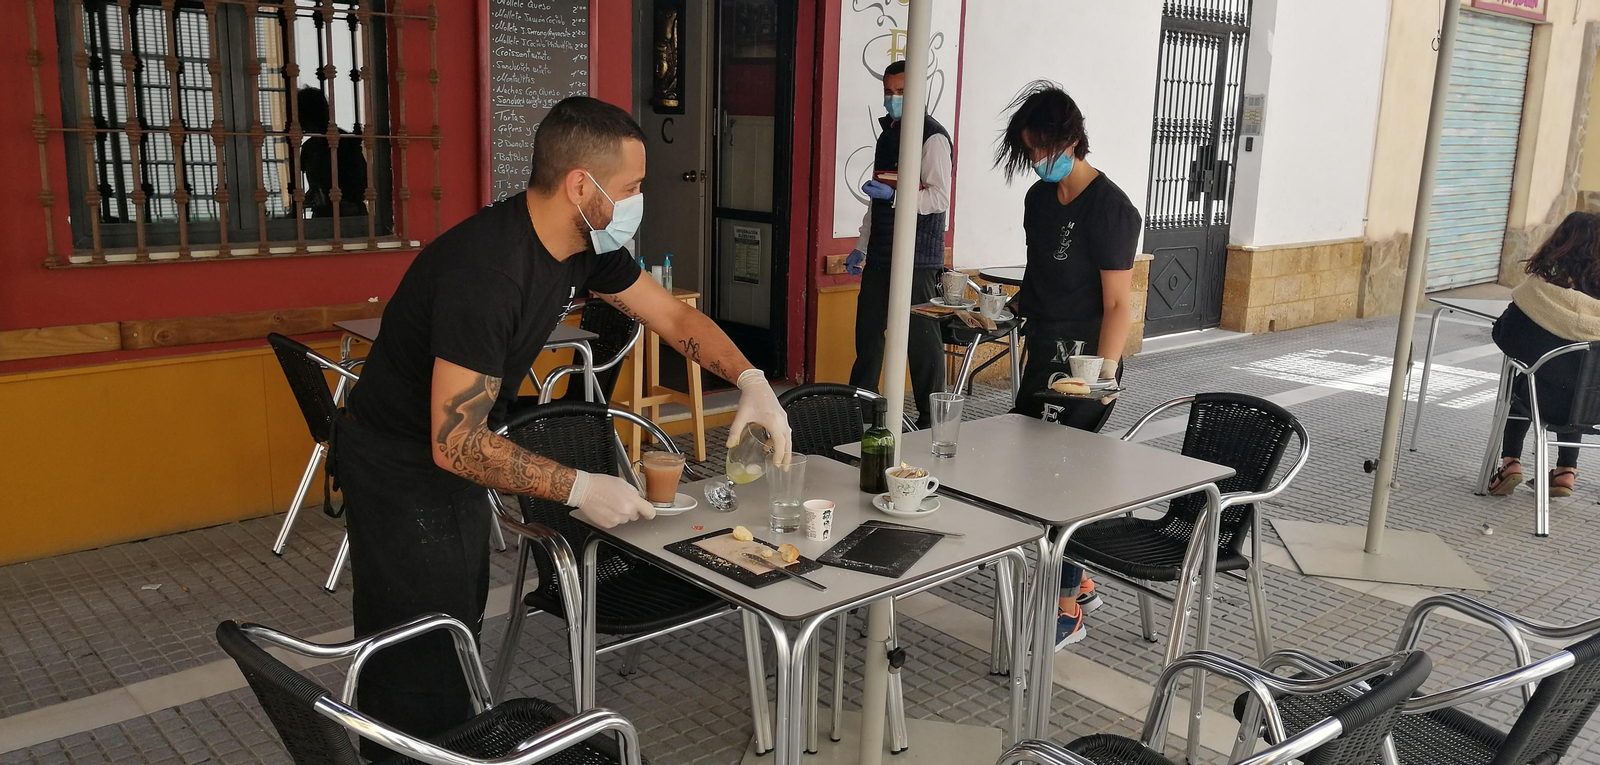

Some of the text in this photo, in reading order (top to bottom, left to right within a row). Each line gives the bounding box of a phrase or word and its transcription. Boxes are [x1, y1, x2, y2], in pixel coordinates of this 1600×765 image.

[527, 0, 552, 10] Queso
[495, 8, 522, 20] Mollete
[495, 20, 519, 34] Mollete
[495, 34, 520, 46] Mollete
[495, 47, 531, 60] Croissant
[496, 60, 531, 72] Sandwich
[496, 84, 523, 96] Nachos
[494, 109, 526, 124] Tartas
[496, 150, 529, 162] Batidos
